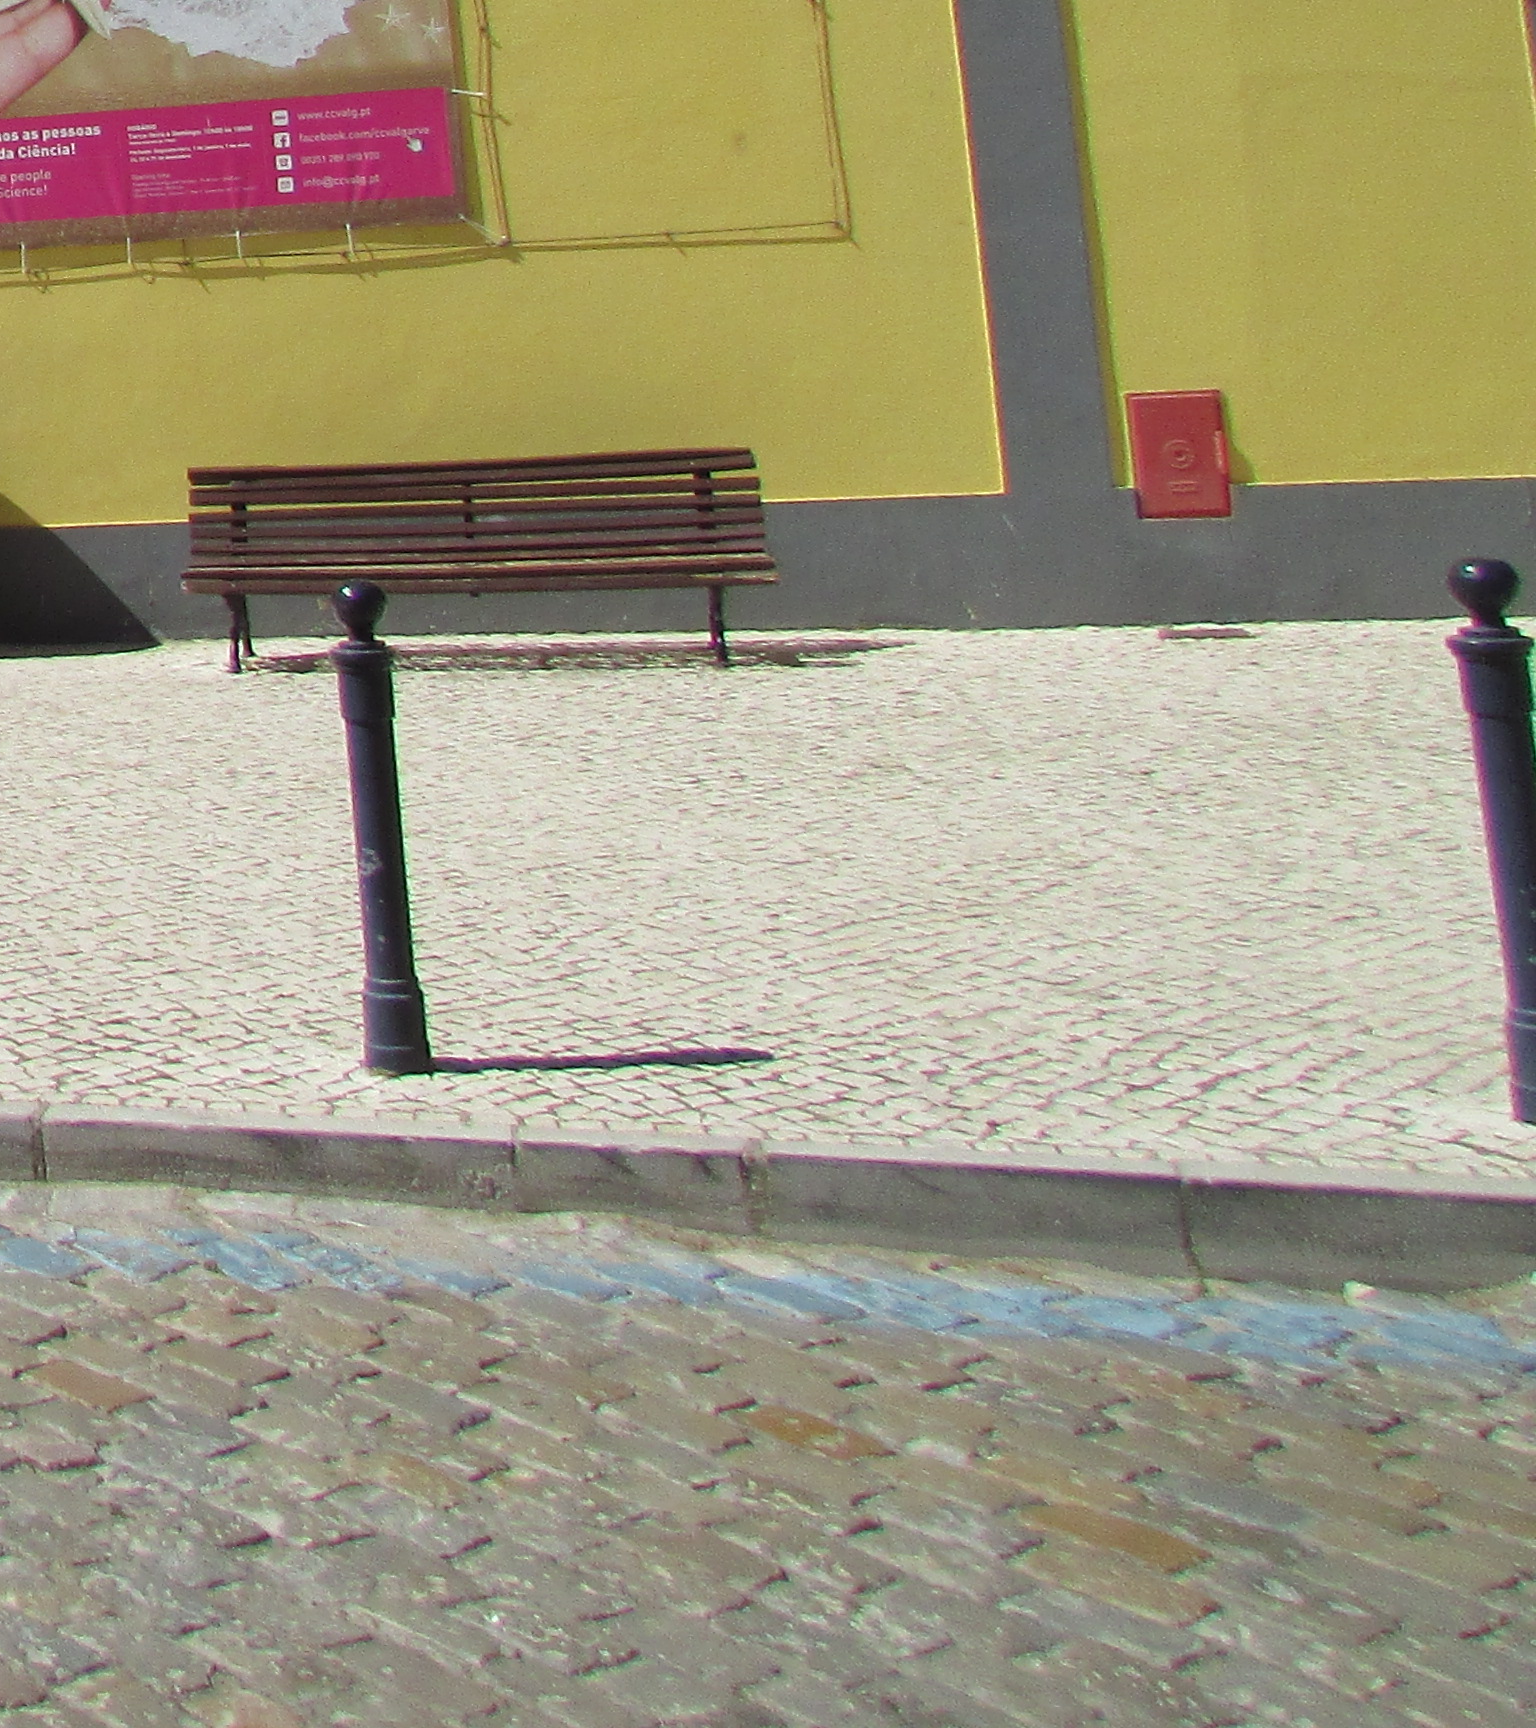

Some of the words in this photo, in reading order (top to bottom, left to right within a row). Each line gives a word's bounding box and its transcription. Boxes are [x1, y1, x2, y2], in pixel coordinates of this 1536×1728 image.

[297, 107, 371, 121] www.ccvalg.pt
[22, 130, 39, 141] as
[42, 125, 101, 142] pessoas
[17, 143, 76, 159] Ciência!
[10, 169, 51, 184] people
